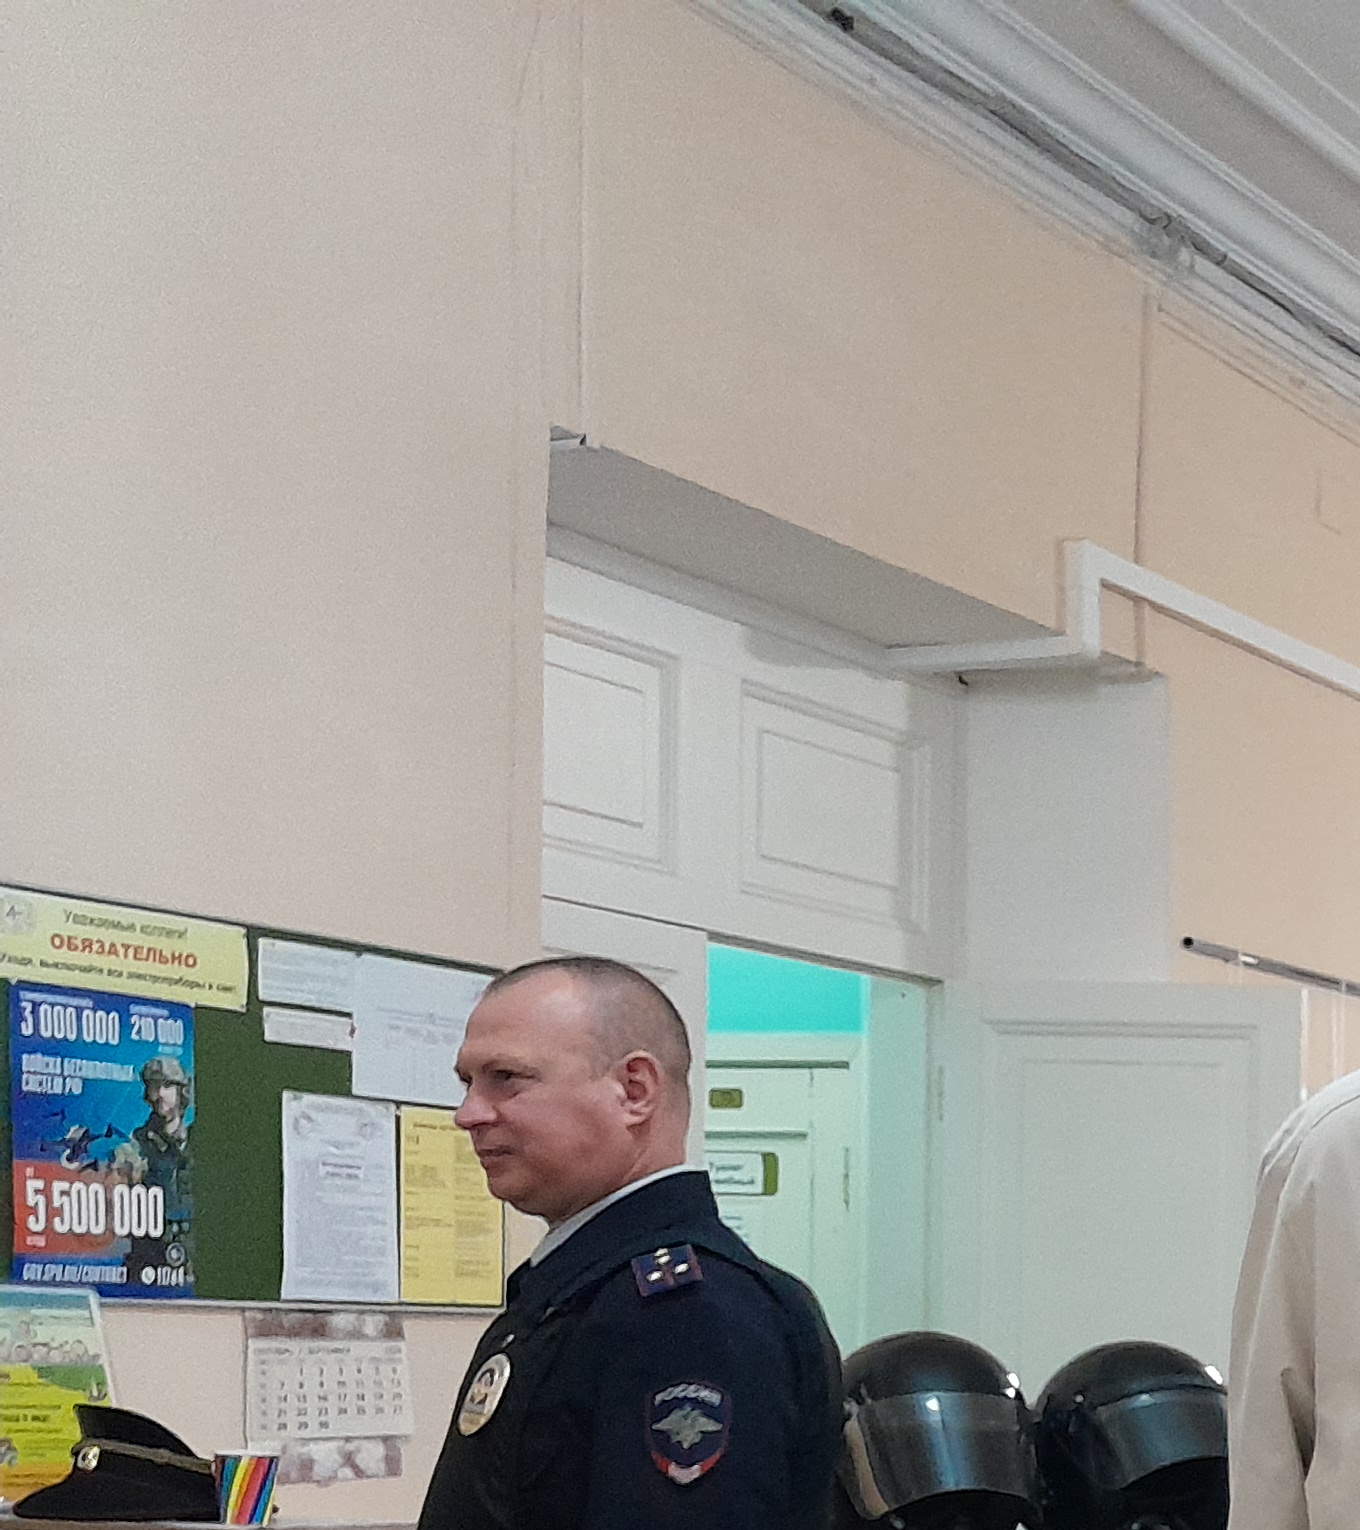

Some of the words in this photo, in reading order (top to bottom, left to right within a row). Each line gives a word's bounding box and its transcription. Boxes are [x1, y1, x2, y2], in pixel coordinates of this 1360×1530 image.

[50, 933, 198, 969] ОБЯЗАТЕЛЬНО
[20, 1001, 34, 1037] 3
[39, 1002, 77, 1042] 000
[82, 1009, 120, 1045] 000
[26, 1178, 47, 1233] 5
[52, 1180, 106, 1235] 500
[113, 1183, 164, 1238] 000
